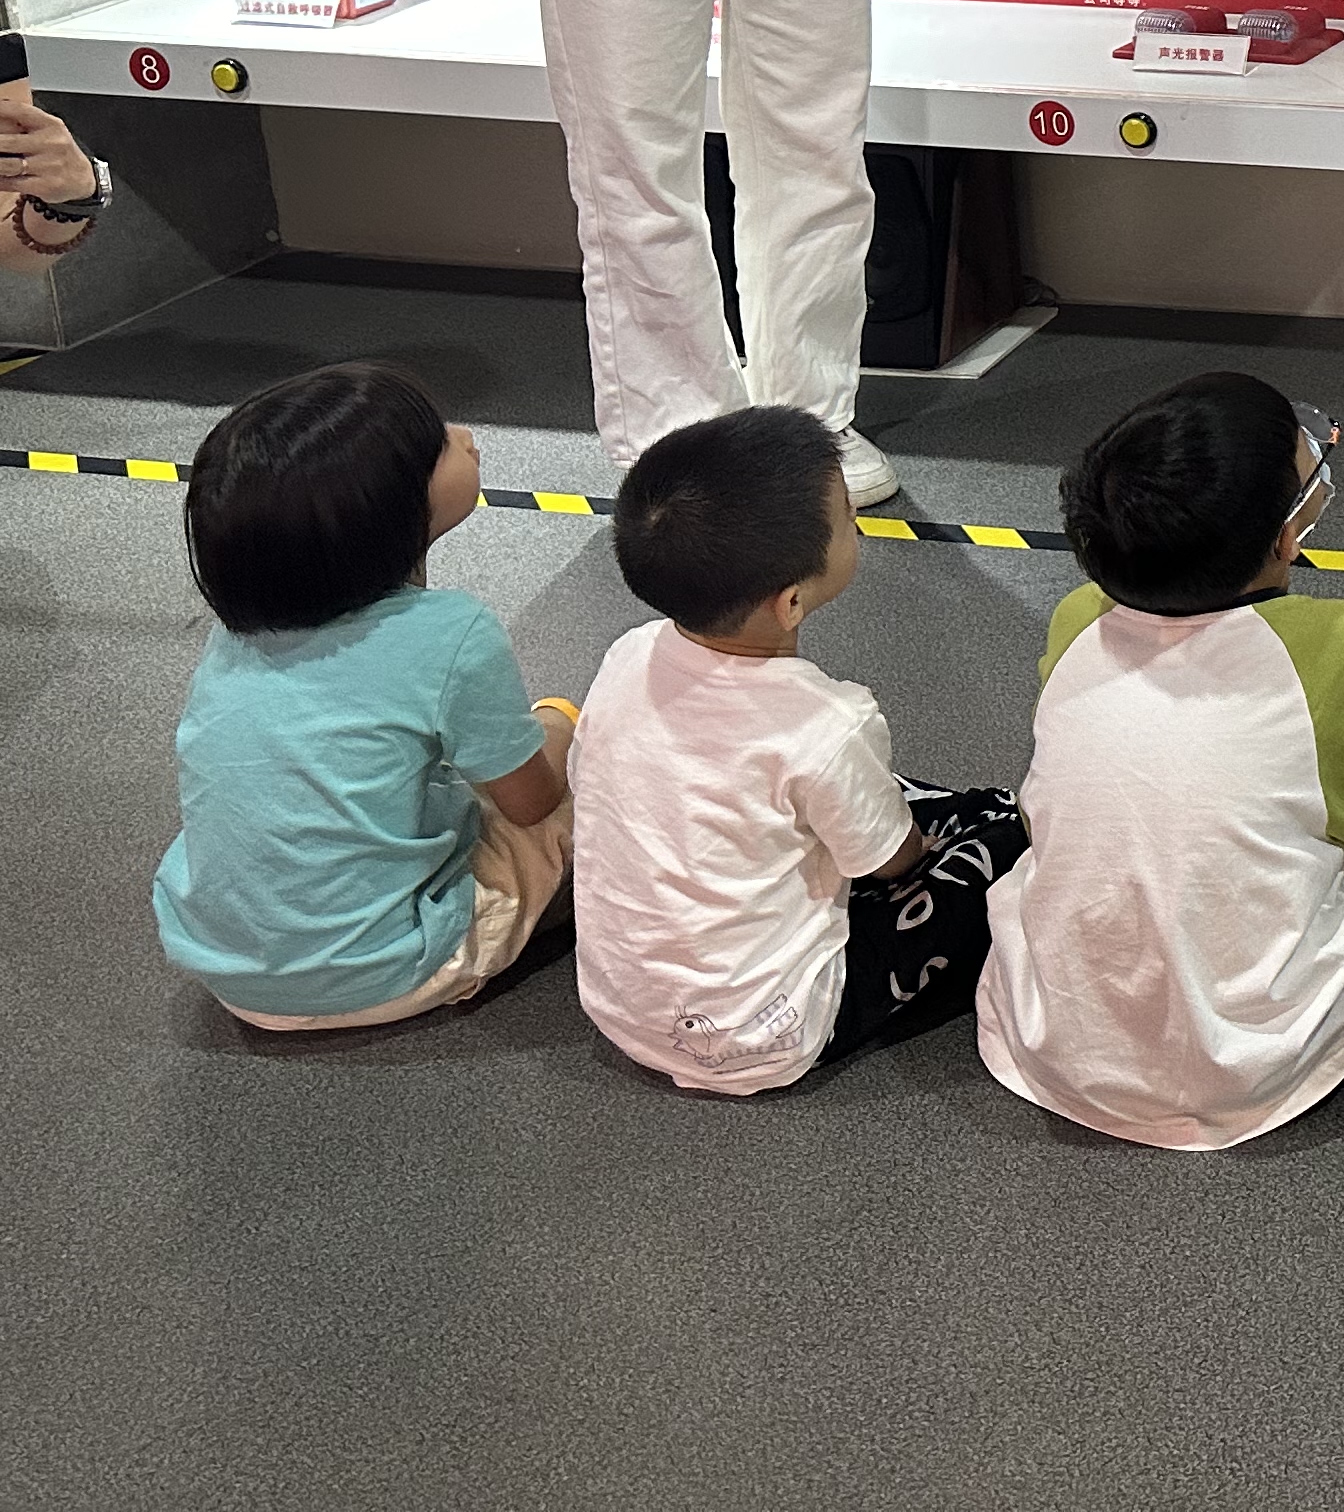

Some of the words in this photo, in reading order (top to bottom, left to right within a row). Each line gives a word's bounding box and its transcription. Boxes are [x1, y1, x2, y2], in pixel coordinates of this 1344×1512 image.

[1158, 46, 1225, 62] 声光报警器
[142, 55, 159, 83] 8
[1033, 111, 1069, 137] 10
